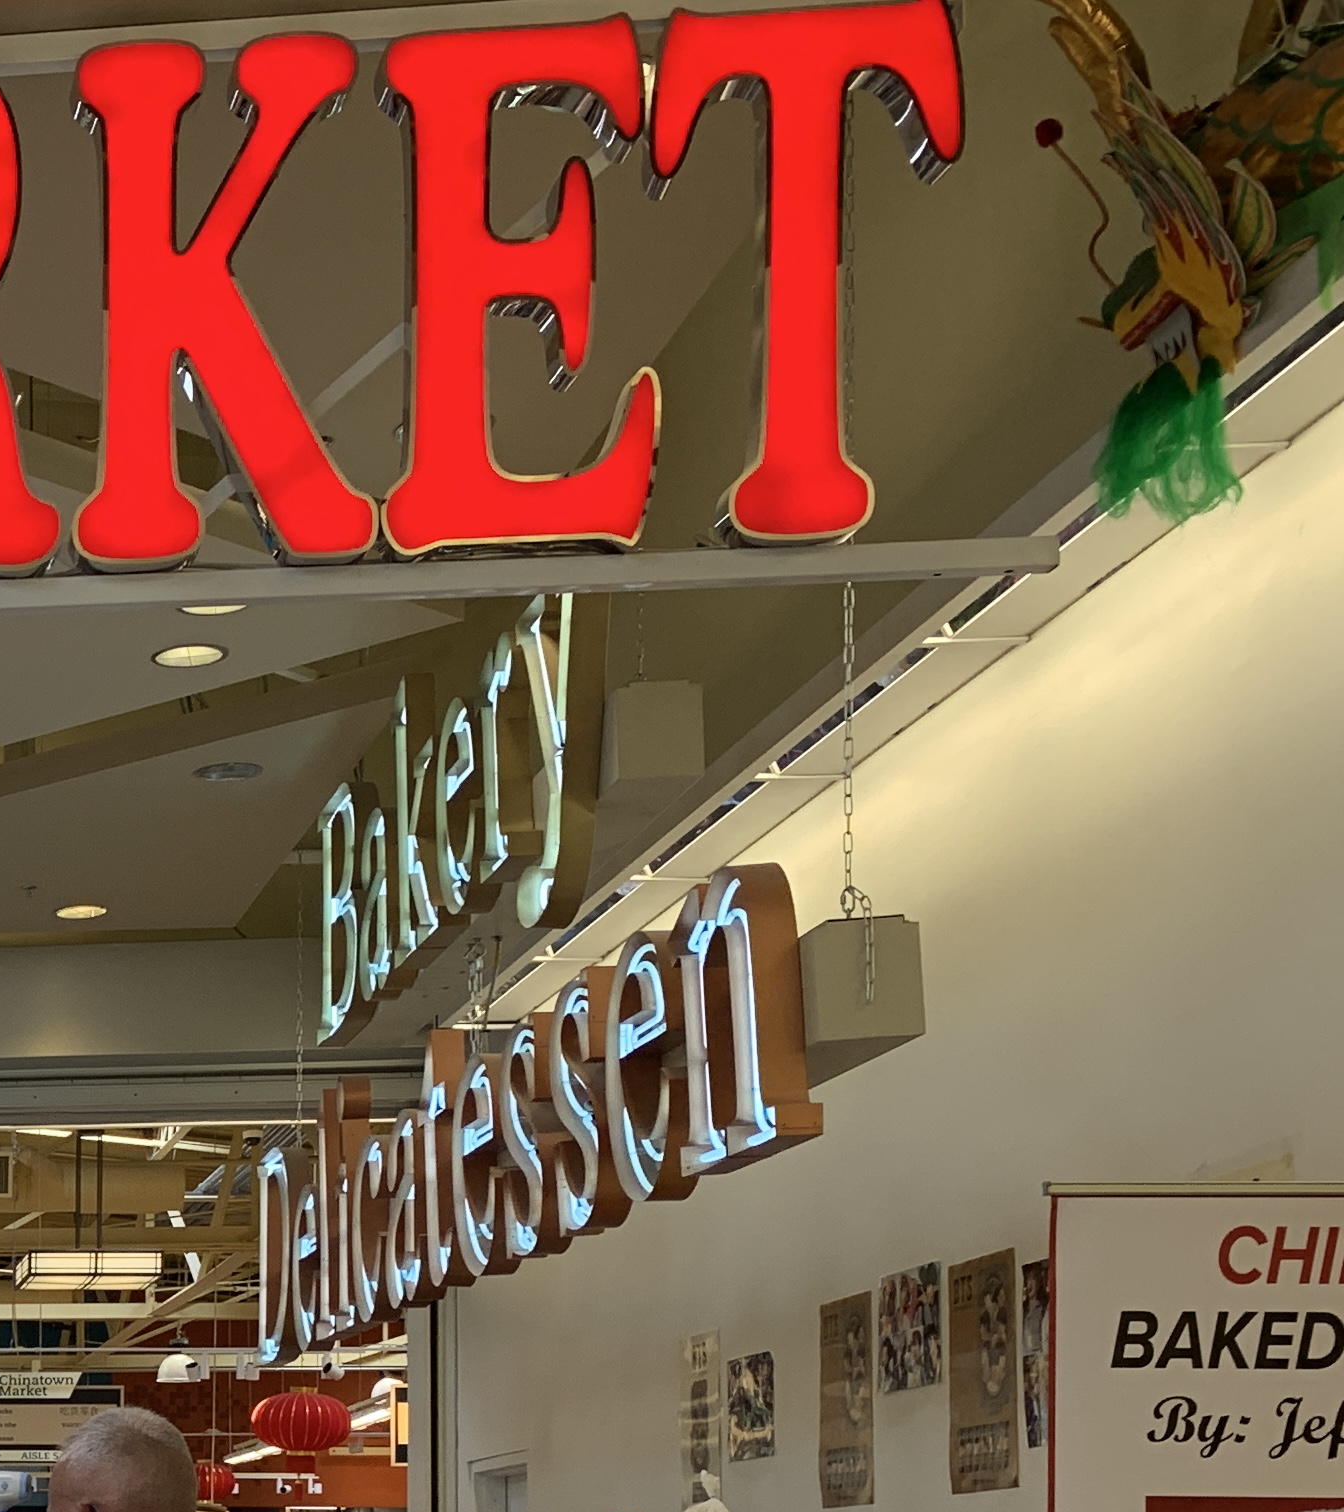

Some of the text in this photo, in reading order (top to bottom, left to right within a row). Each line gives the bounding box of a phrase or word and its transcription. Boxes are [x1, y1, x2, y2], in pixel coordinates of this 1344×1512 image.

[317, 592, 574, 1046] Bakery
[258, 872, 778, 1364] Delicatessen
[1218, 1225, 1344, 1285] CHI
[1110, 1310, 1344, 1370] BAKED
[20, 1451, 50, 1460] AISLE
[1147, 1395, 1251, 1459] By:
